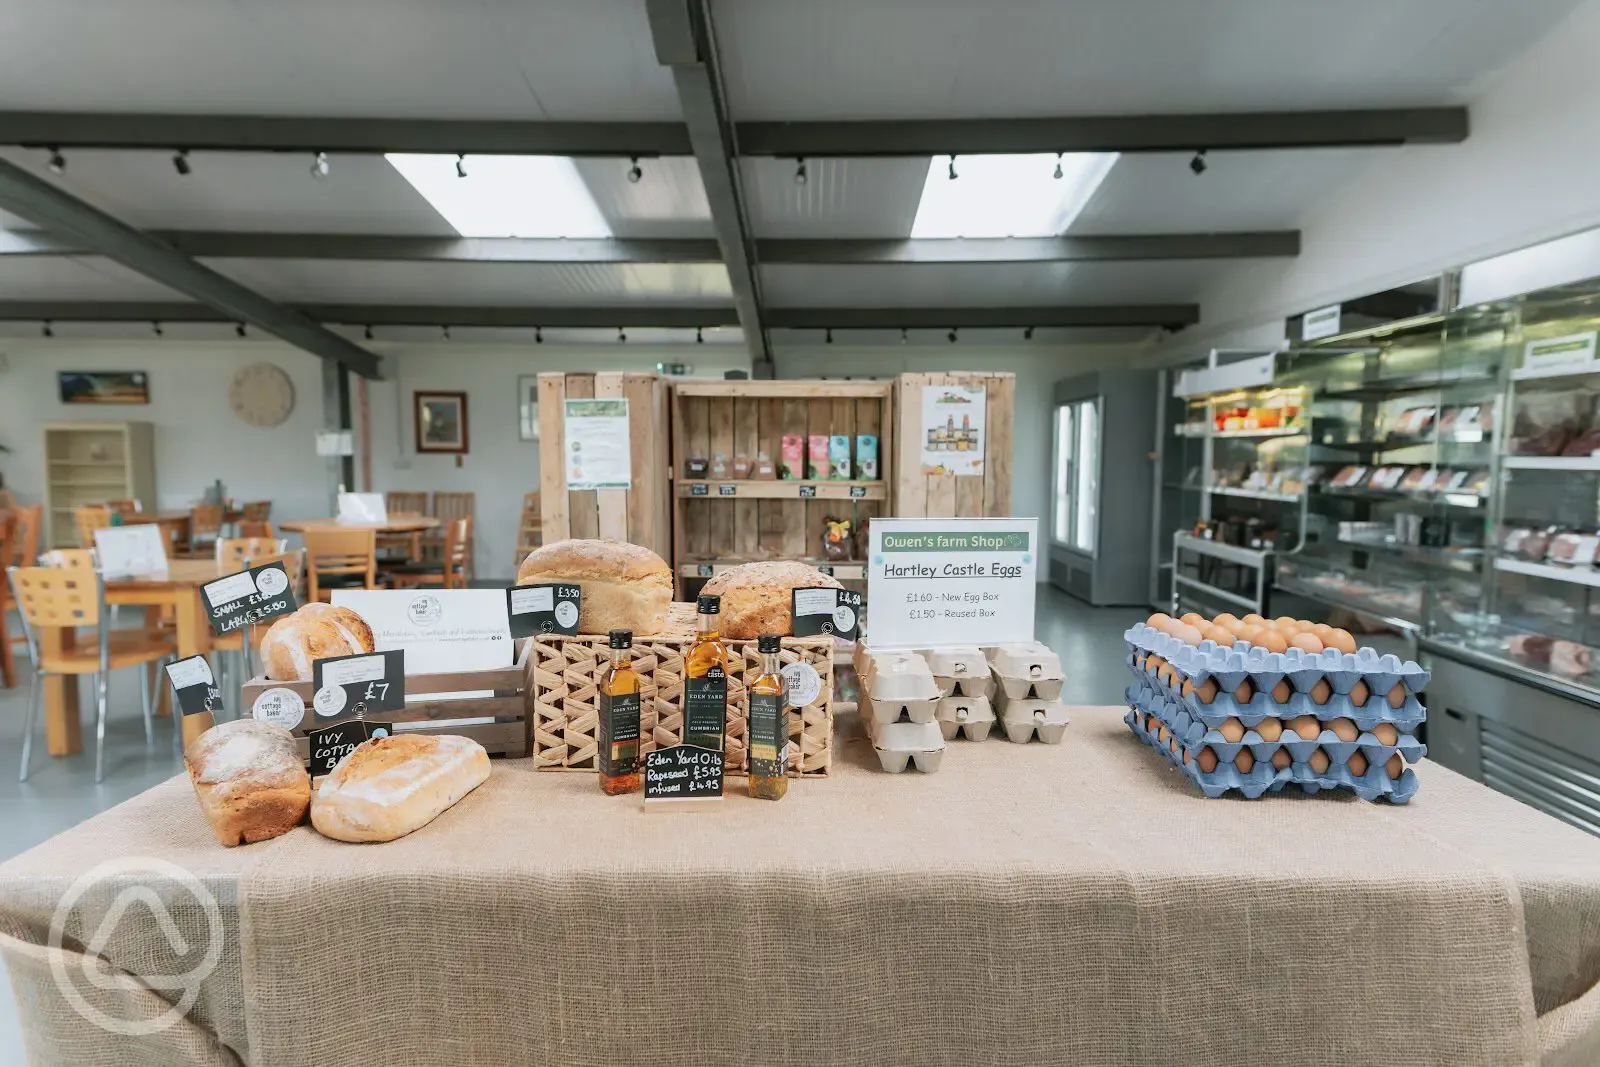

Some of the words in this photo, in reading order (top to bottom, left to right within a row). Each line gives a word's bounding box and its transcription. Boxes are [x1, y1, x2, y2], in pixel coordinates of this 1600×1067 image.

[884, 536, 934, 548] Owen's
[936, 535, 968, 548] farm
[971, 535, 1004, 549] Shop
[884, 563, 937, 580] Hartley
[943, 562, 985, 576] Castle
[991, 562, 1022, 578] Eggs
[906, 592, 933, 603] £1.60
[942, 592, 962, 602] New
[964, 592, 980, 603] Egg
[982, 592, 999, 601] Box
[213, 601, 244, 618] SMALL
[909, 608, 936, 619] £1.50
[944, 608, 976, 619] Reused
[979, 608, 996, 618] Box
[364, 682, 390, 701] £7
[261, 703, 282, 711] cottage
[266, 709, 281, 717] baker
[319, 732, 343, 744] IVY
[315, 743, 356, 759] COTTA
[647, 753, 673, 766] Eden
[676, 749, 698, 765] Yard
[700, 753, 722, 765] Oils
[648, 768, 688, 781] Rapeseed
[693, 765, 722, 780] £5.95
[688, 779, 719, 792] £4.95
